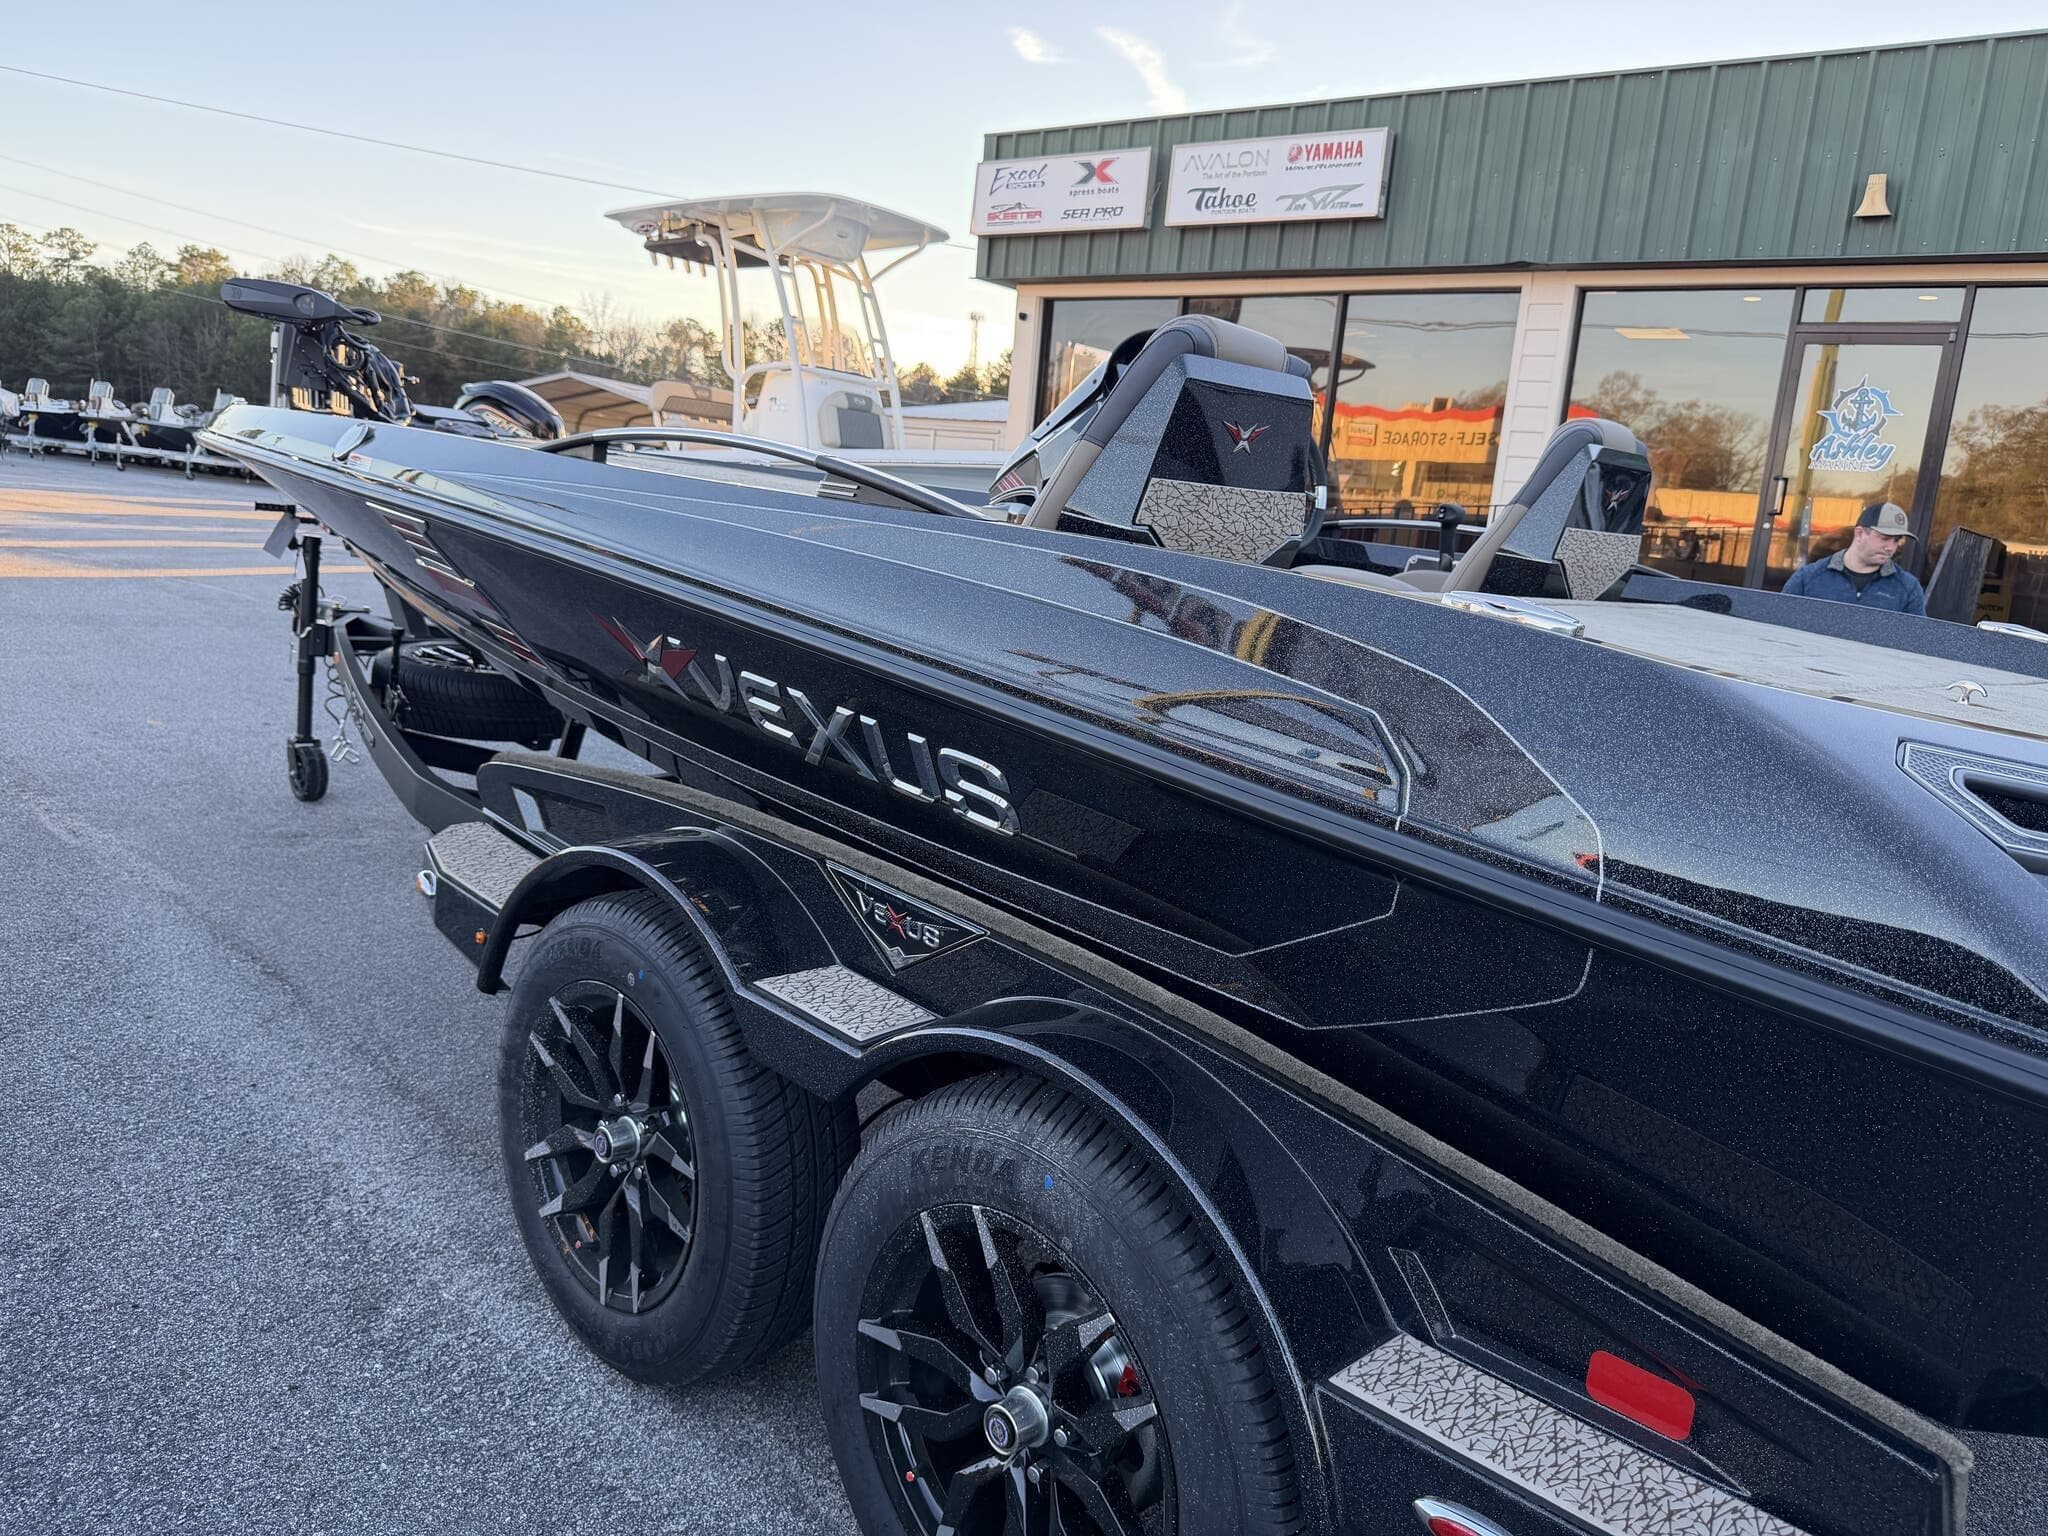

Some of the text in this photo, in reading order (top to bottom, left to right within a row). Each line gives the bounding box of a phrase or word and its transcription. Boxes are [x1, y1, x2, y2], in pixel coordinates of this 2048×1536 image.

[1184, 149, 1270, 172] AVALON
[1305, 140, 1363, 161] YAMAHA
[989, 163, 1048, 196] Excel
[1069, 186, 1120, 197] xpress boats
[1187, 186, 1258, 211] Tahoe
[987, 210, 1042, 221] SKEETER
[1060, 206, 1124, 219] SEA PRO
[1810, 433, 1895, 470] Ashley
[667, 635, 1021, 837] VEXUS
[856, 890, 940, 948] VEXUS
[910, 1144, 1015, 1184] KENDA
